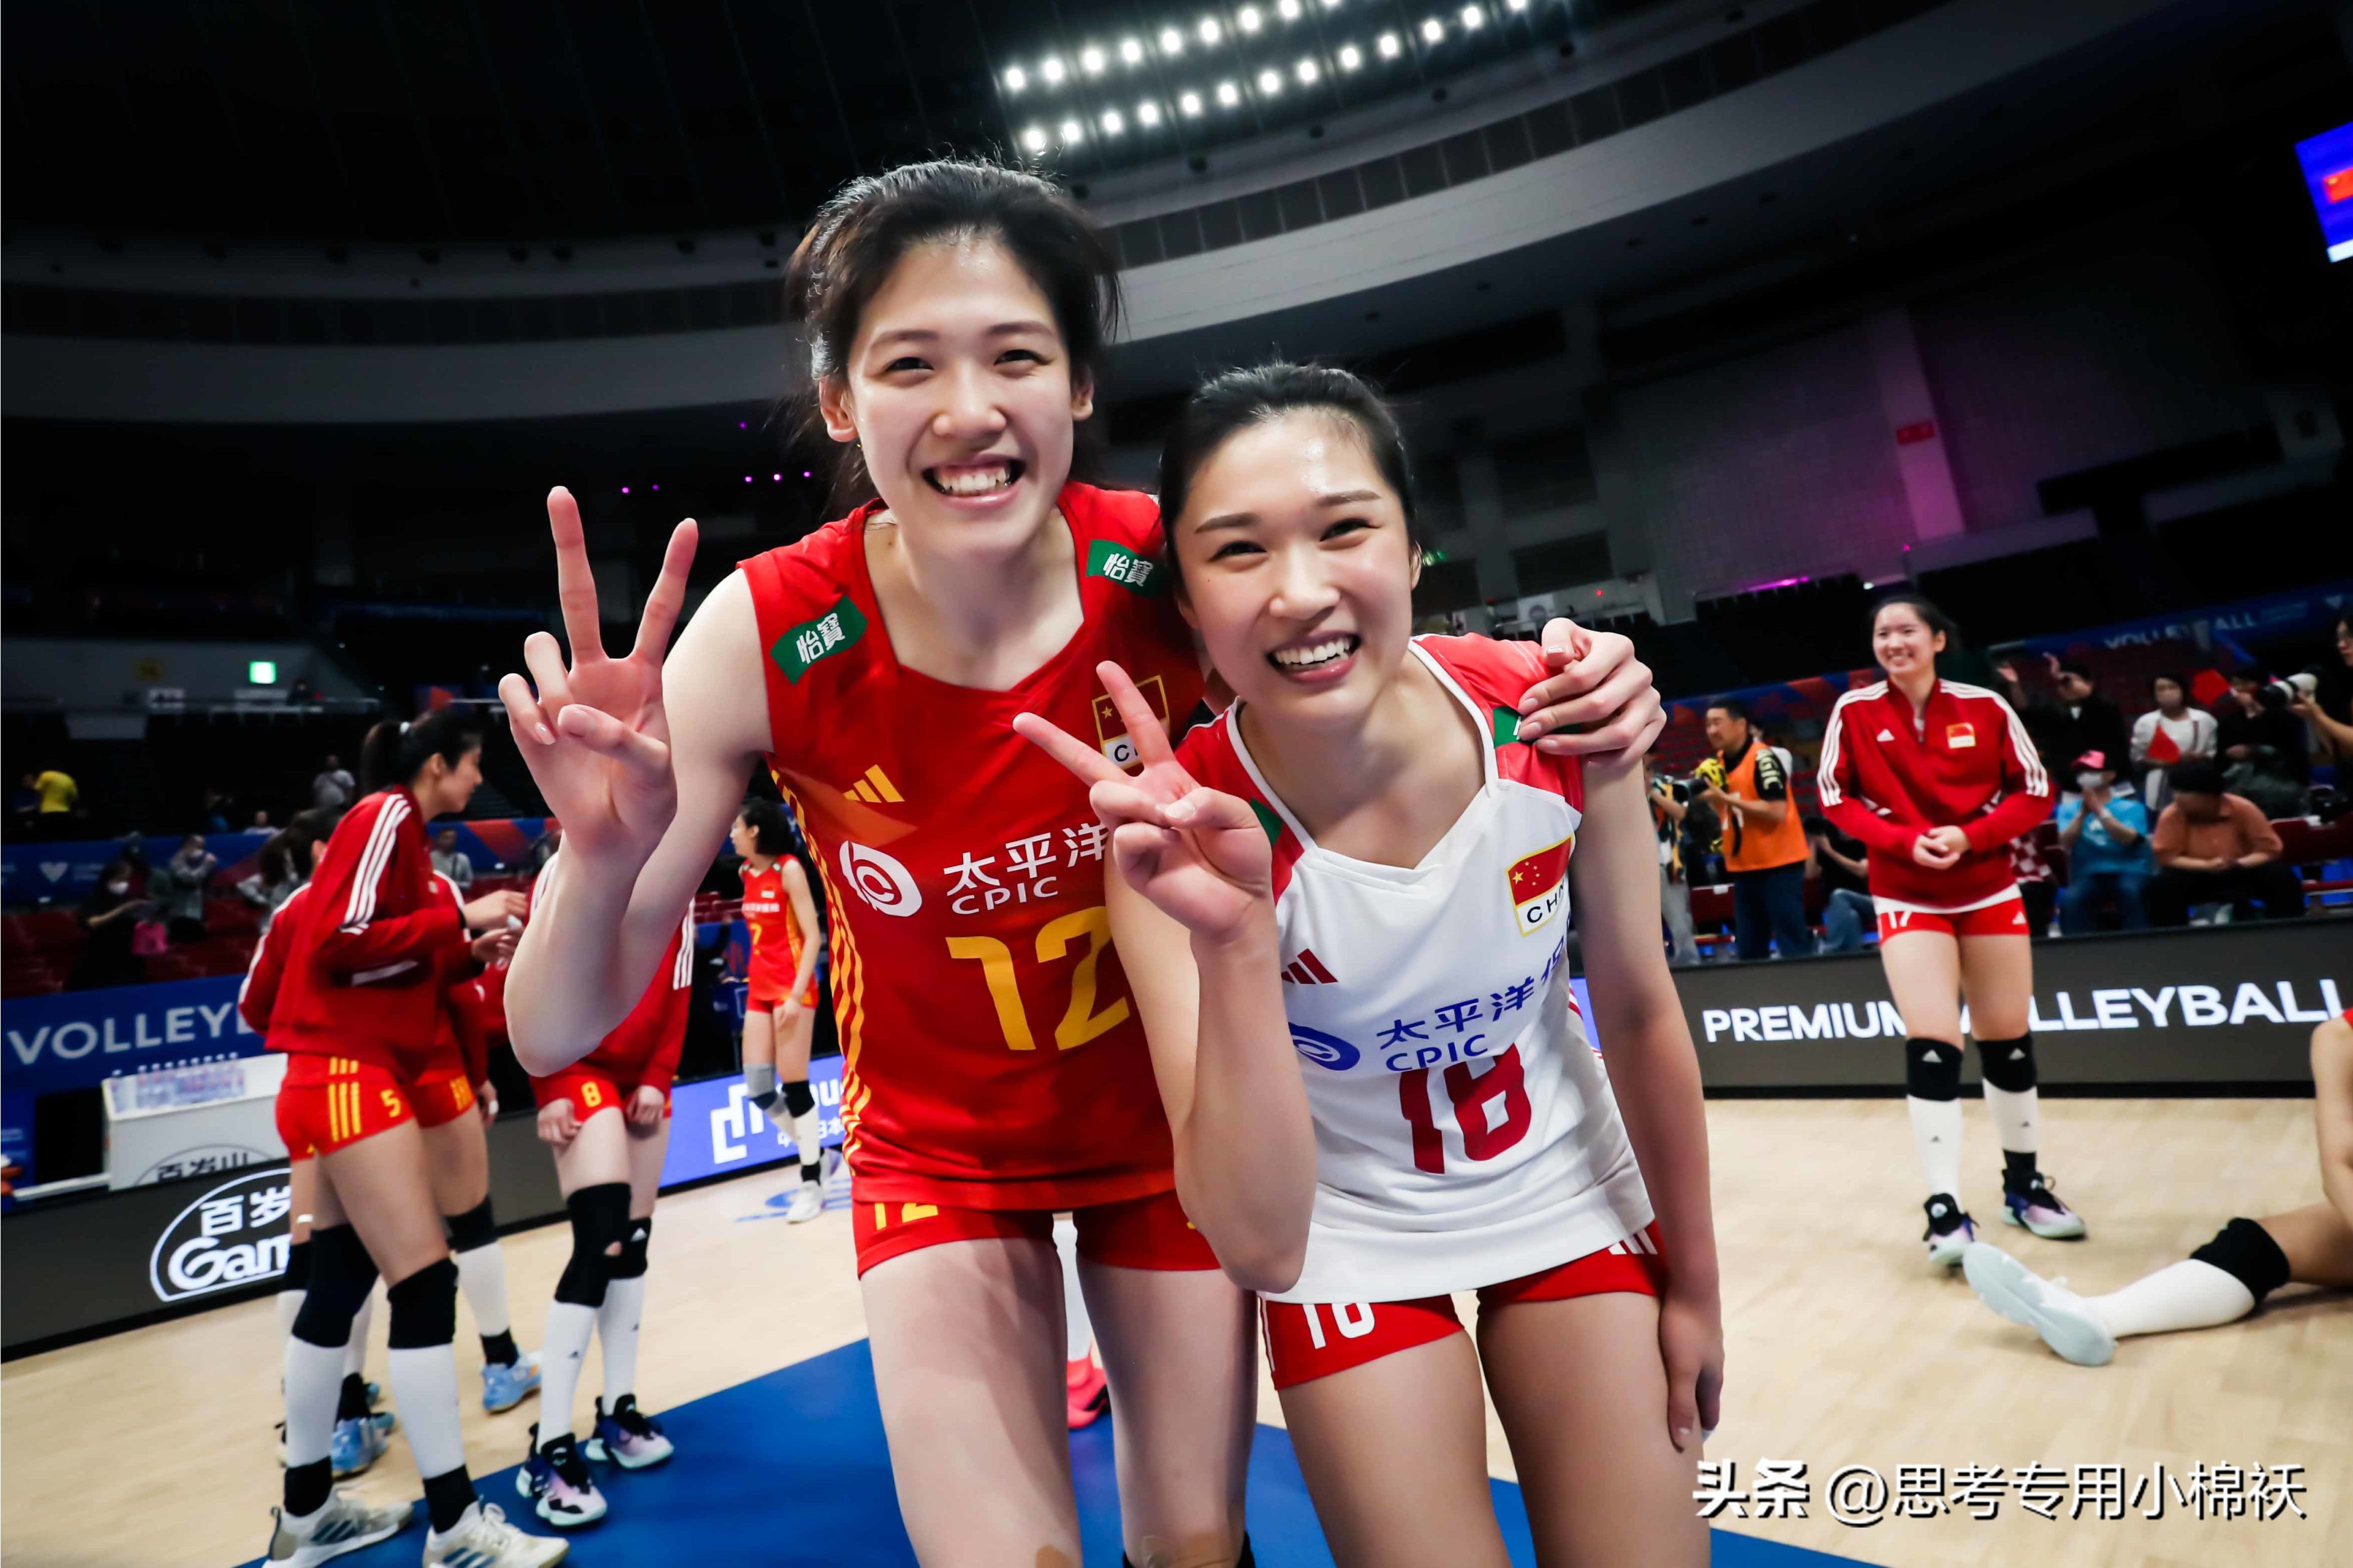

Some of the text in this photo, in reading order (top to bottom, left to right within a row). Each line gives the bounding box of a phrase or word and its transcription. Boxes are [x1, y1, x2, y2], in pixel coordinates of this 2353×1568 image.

[1103, 553, 1153, 586] 怡寶
[796, 613, 845, 664] 怡寶
[952, 876, 1058, 915] CPIC
[945, 906, 1130, 1051] 12
[1961, 979, 2343, 1034] LLEYBALL
[1385, 1034, 1488, 1071] CPIC
[380, 1089, 401, 1118] 5
[581, 1081, 602, 1107] 8
